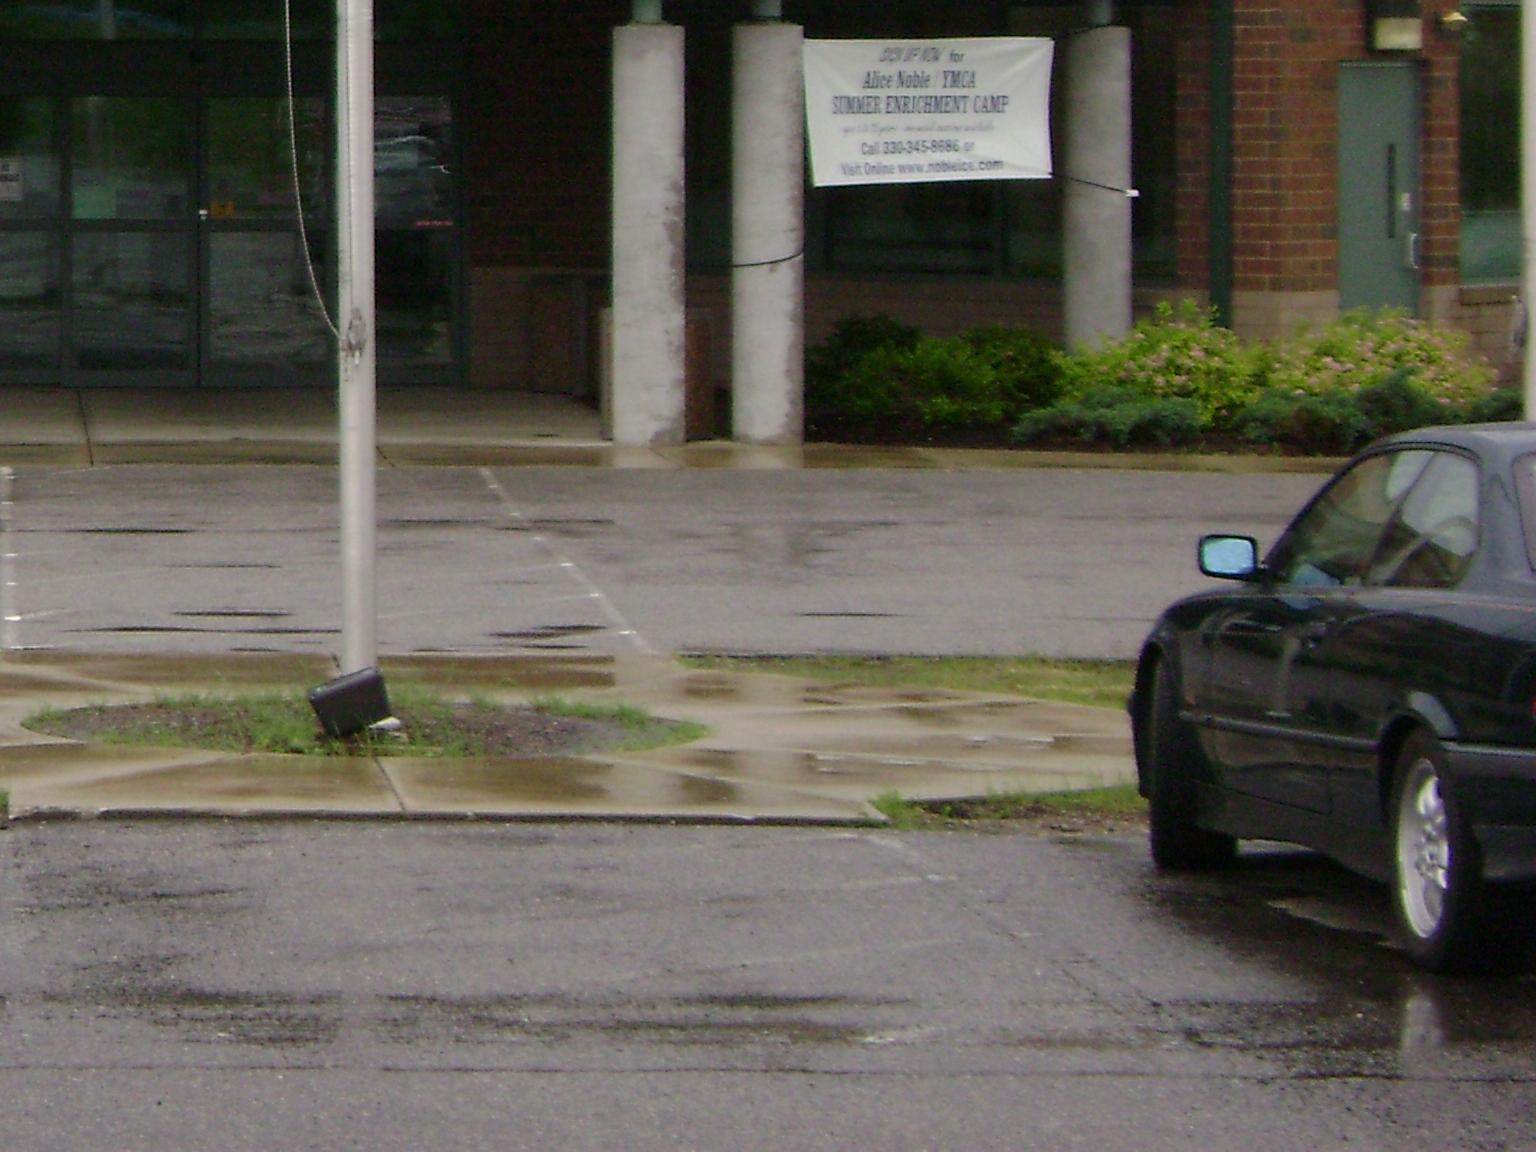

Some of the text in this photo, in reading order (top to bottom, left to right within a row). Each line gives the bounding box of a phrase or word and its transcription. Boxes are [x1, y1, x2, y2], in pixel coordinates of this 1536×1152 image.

[949, 49, 965, 63] for
[861, 69, 893, 89] Alice
[896, 69, 931, 89] Noble
[942, 70, 977, 89] YMCA
[831, 94, 1009, 115] SUMMER ENRICHMENT CAMP
[860, 141, 881, 156] Call
[864, 162, 896, 176] Online
